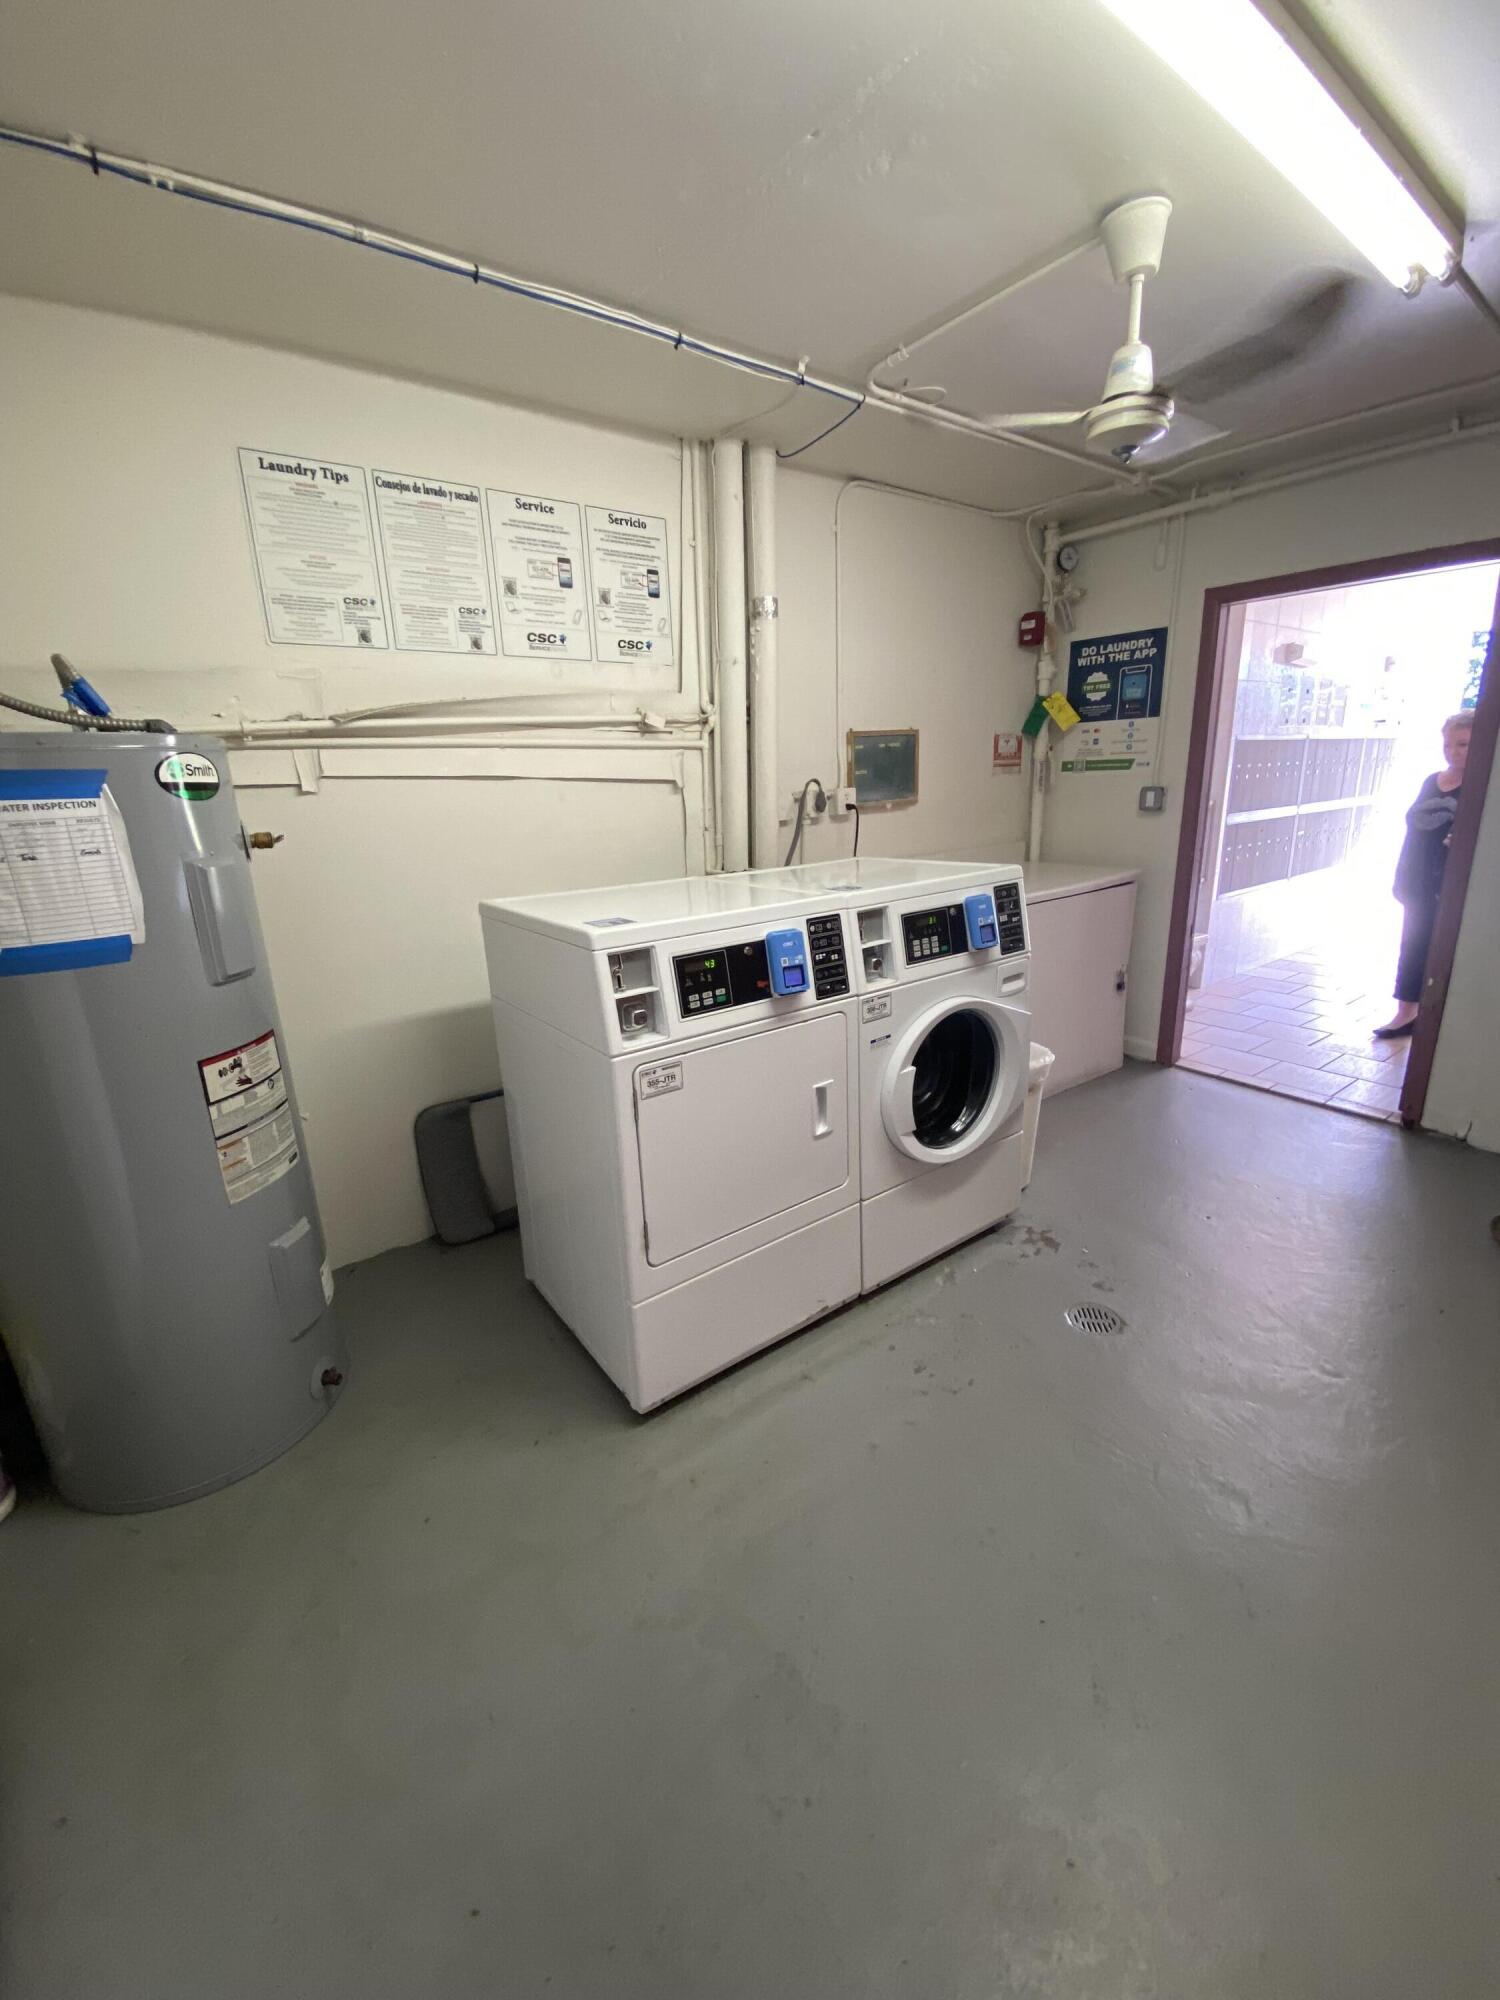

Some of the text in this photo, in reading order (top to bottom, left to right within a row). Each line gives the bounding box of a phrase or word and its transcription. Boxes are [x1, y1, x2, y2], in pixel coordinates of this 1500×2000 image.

[258, 457, 349, 484] Laundry Tips
[375, 476, 478, 504] Consejos de lavado y secado
[515, 498, 555, 515] Service
[608, 514, 647, 530] Servicio
[343, 597, 368, 606] CSC
[458, 606, 480, 616] CSC
[527, 632, 557, 644] CSC
[618, 639, 644, 650] CSC
[1082, 637, 1154, 657] DO LAUNDRY
[1077, 647, 1158, 667] WITH THE APP
[185, 764, 214, 777] Smith
[0, 800, 97, 813] ATER INSPECTION
[704, 959, 715, 969] 43
